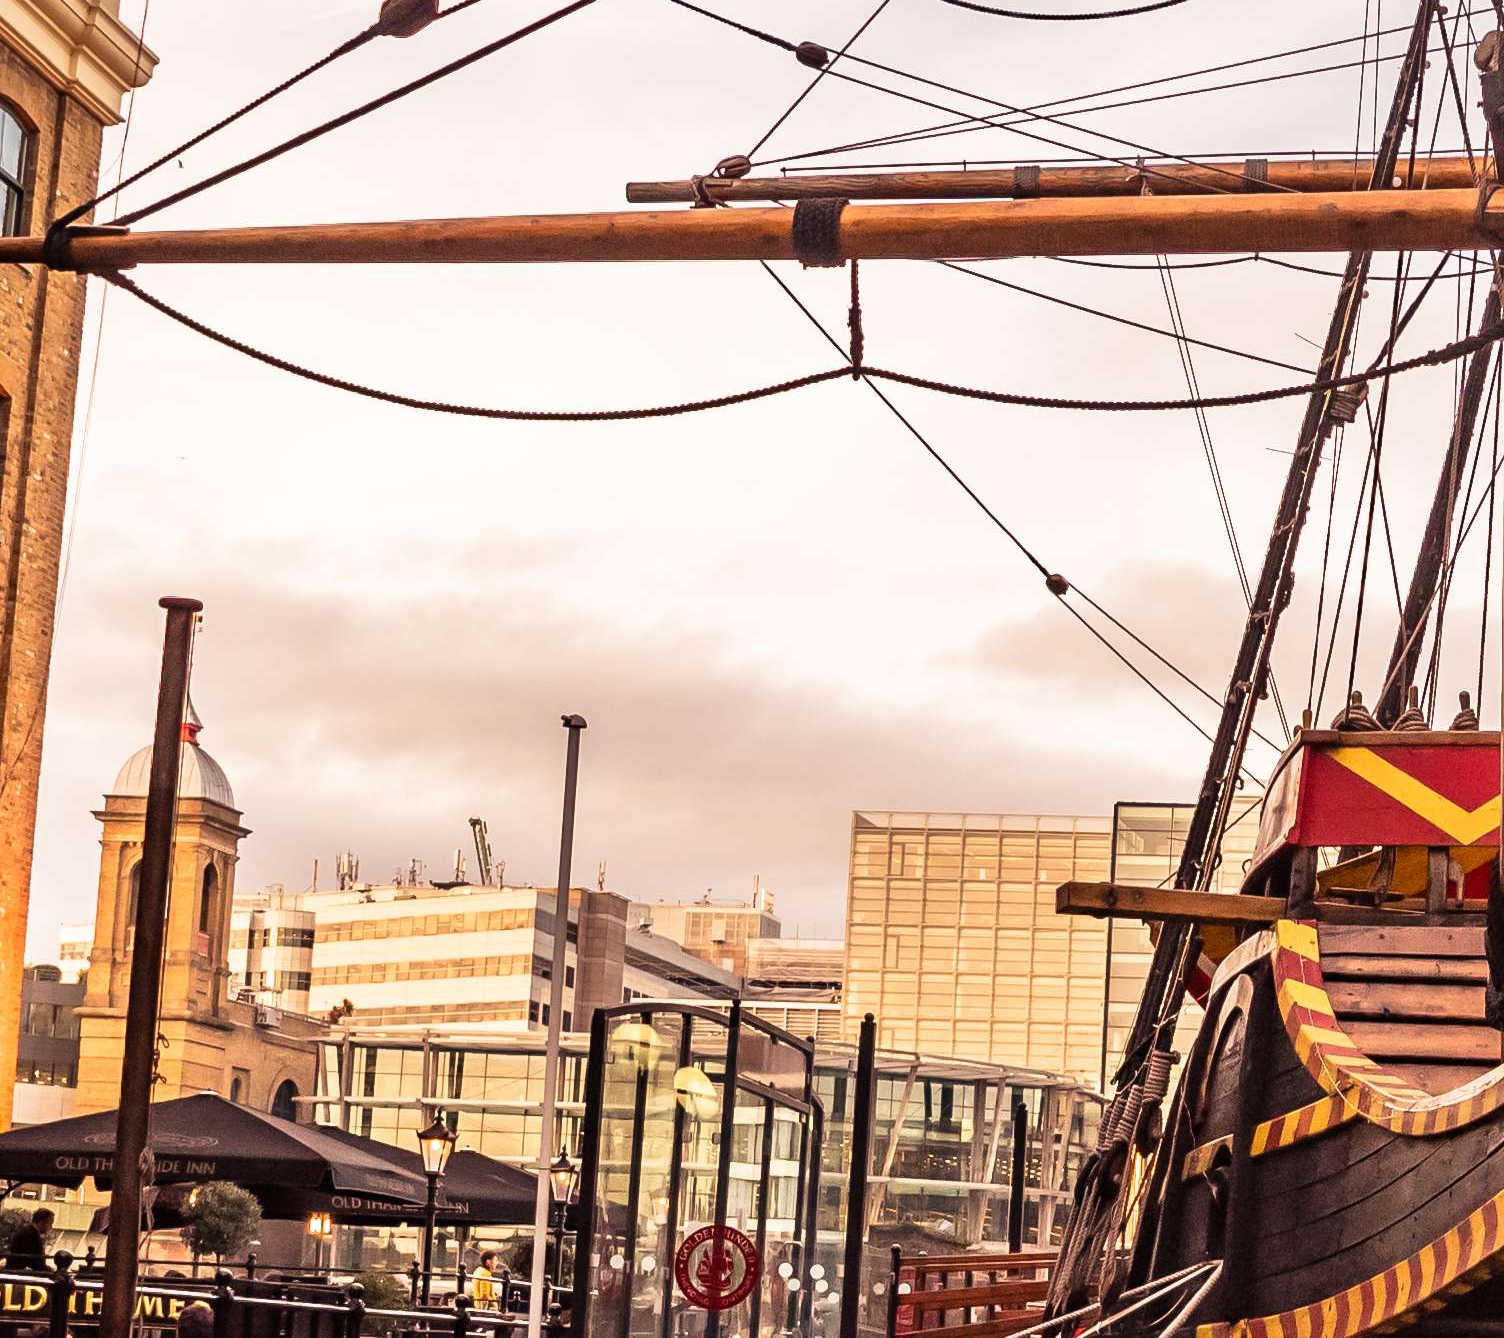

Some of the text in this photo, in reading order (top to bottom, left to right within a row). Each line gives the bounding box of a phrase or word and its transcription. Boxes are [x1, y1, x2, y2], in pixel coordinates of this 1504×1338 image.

[55, 1156, 216, 1175] OLD THIDE INN
[331, 1196, 362, 1210] OLD
